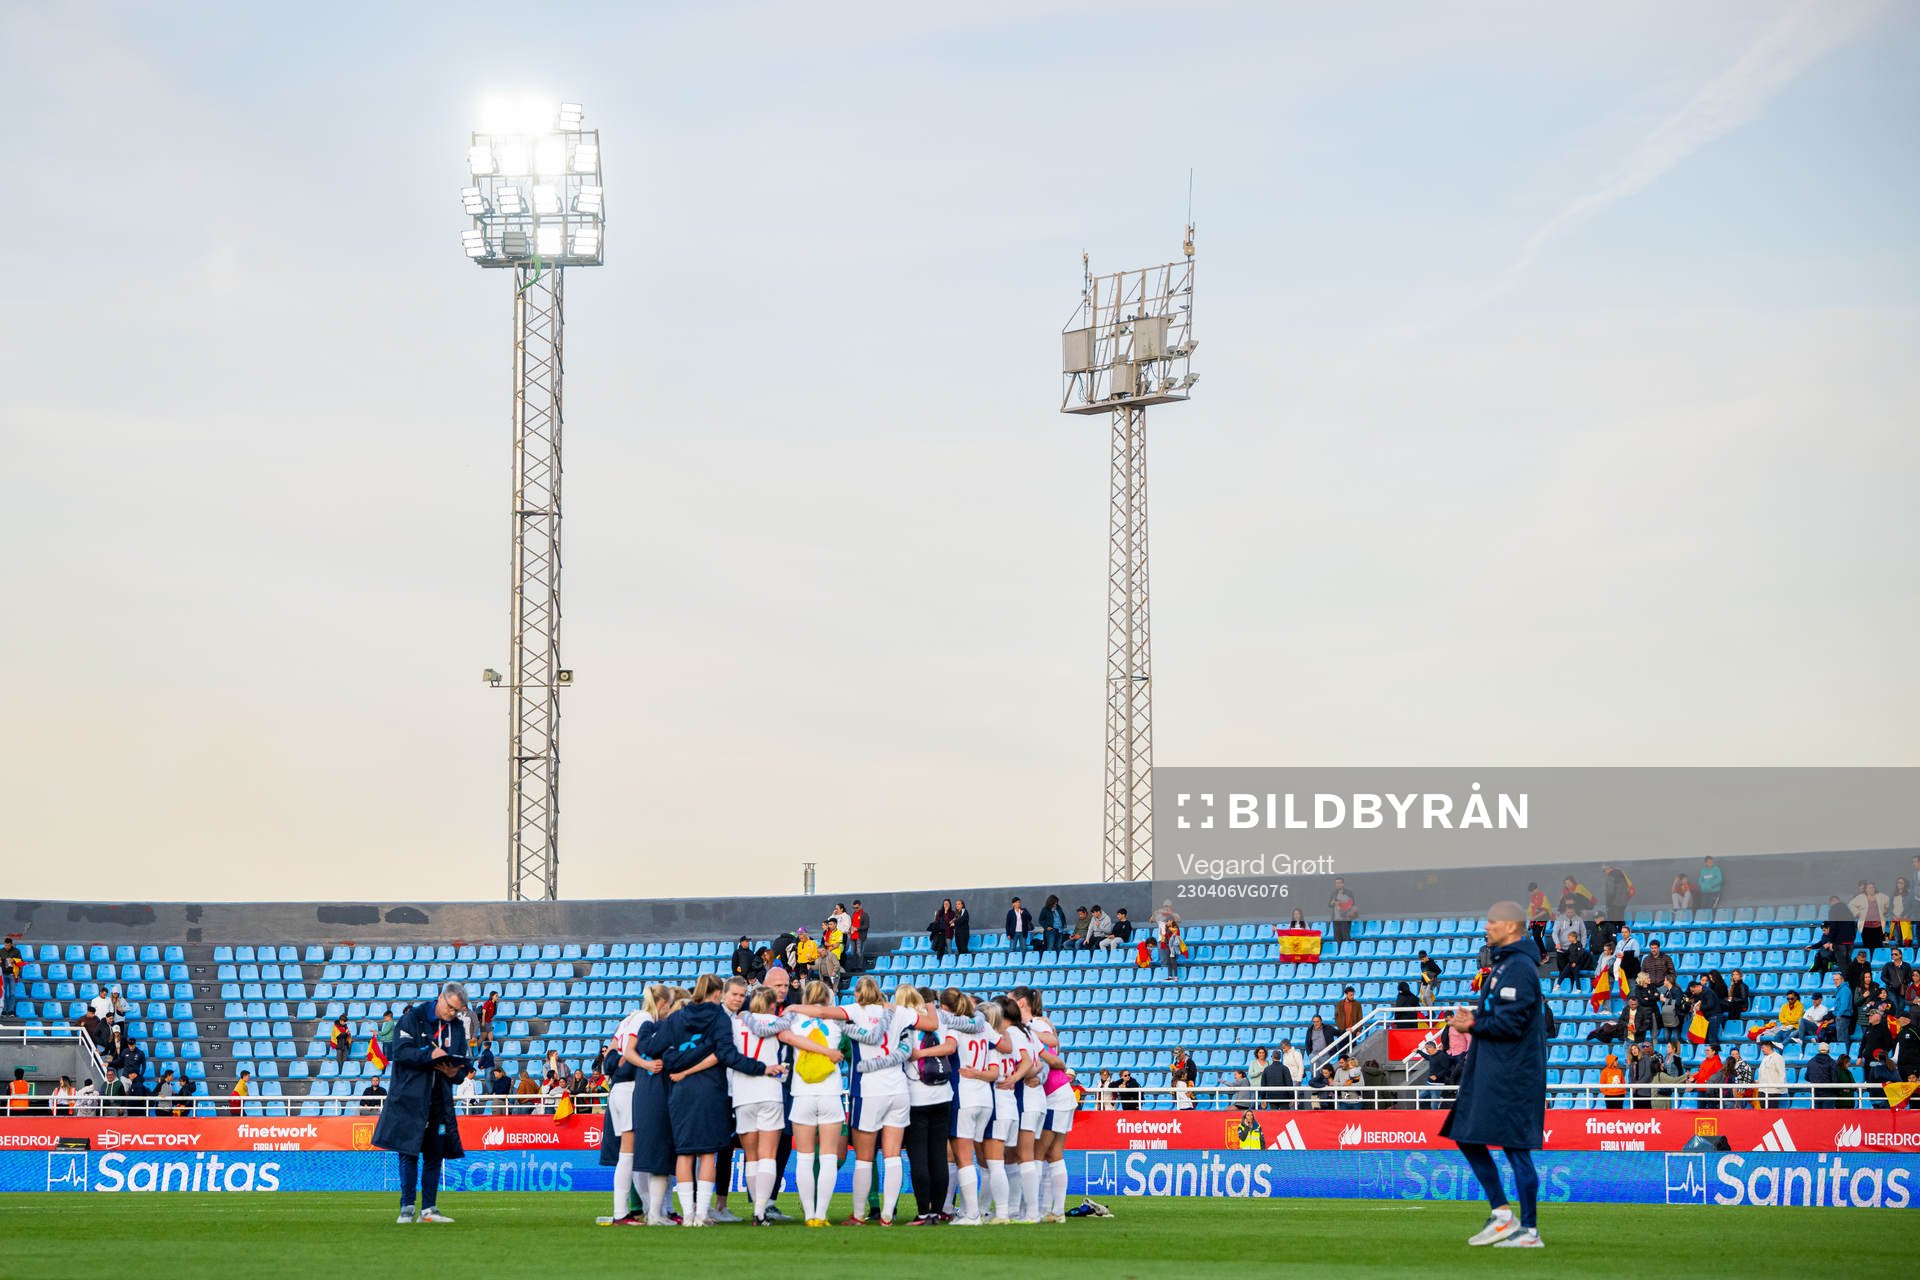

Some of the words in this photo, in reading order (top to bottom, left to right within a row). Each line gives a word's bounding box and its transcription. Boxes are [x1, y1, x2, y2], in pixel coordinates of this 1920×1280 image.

[237, 1124, 318, 1138] finetwork
[1116, 1118, 1182, 1134] finetwork
[1585, 1118, 1661, 1134] finetwork
[121, 1134, 201, 1146] FACTORY
[506, 1133, 559, 1144] IBERDROLA
[1363, 1131, 1427, 1144] IBERDROLA
[1864, 1132, 1920, 1146] IBERDRO
[95, 1151, 281, 1192] Sanitas
[1123, 1151, 1273, 1198] Sanitas
[1714, 1152, 1911, 1209] Sanitas
